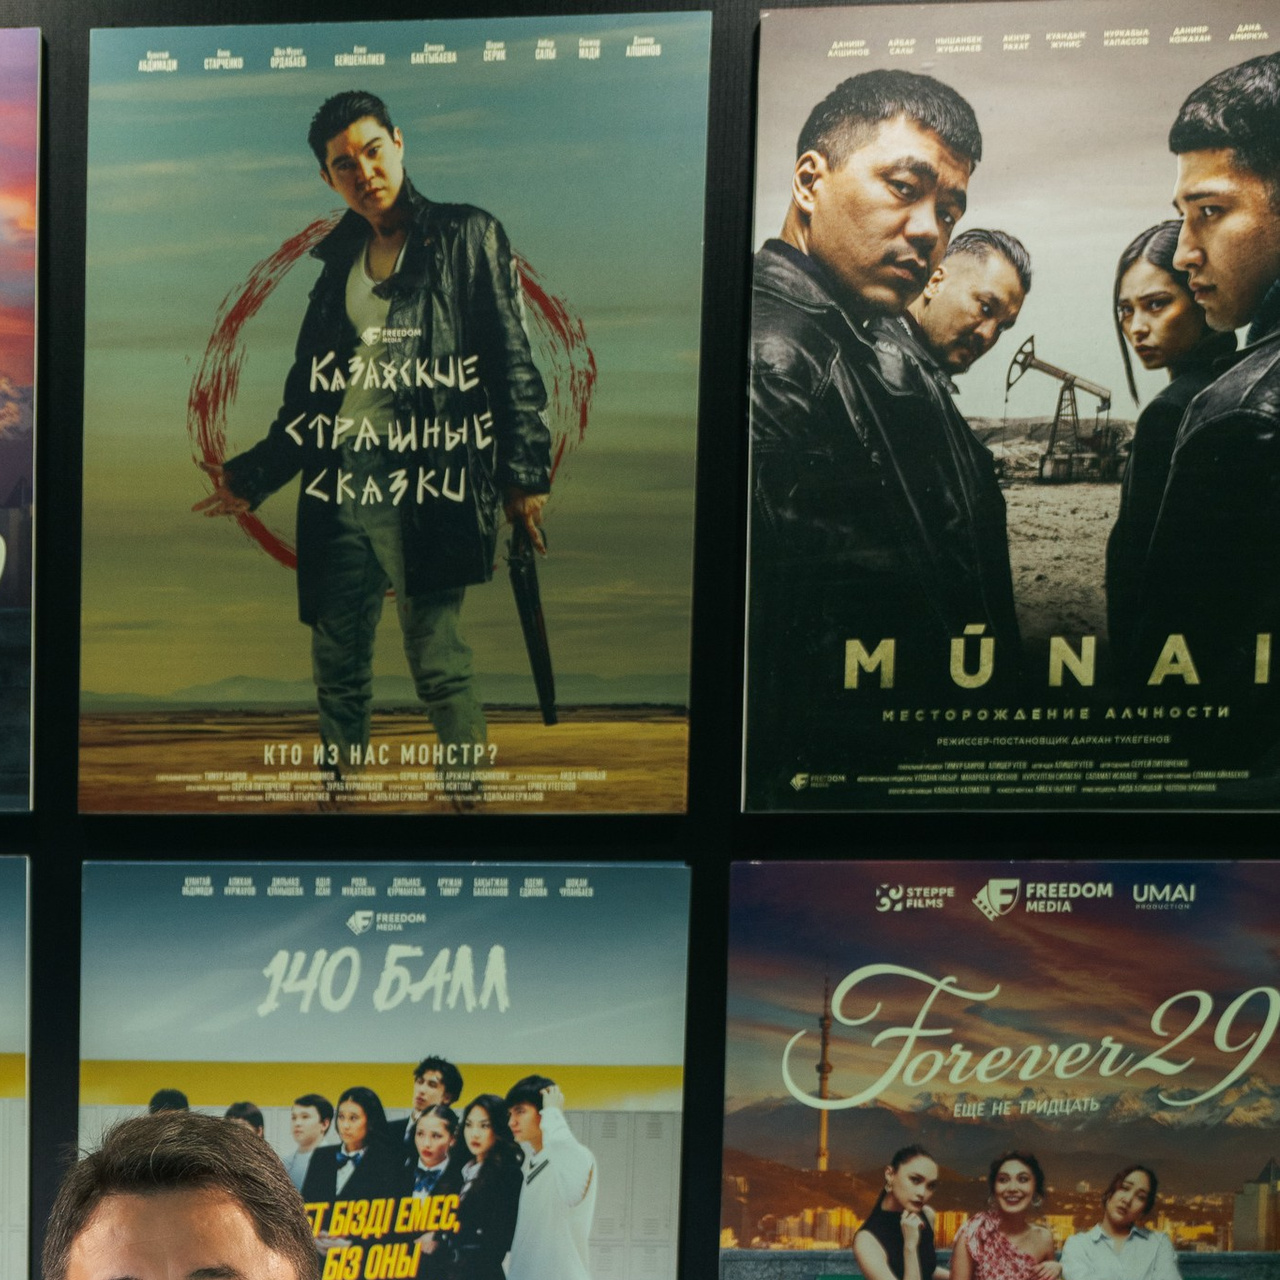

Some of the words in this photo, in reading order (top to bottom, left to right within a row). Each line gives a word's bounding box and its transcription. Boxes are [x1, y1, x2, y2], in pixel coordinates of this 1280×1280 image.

[305, 466, 466, 506] СКАЗКИ
[882, 706, 1090, 722] МЕСТОРОЖДЕНИЕ
[1104, 705, 1230, 720] АЛЧНОСТИ
[264, 744, 302, 766] КТО
[312, 744, 339, 766] ИЗ
[350, 744, 390, 766] НАС
[400, 743, 498, 766] МОНСТР?
[906, 887, 955, 897] STEPPE
[1026, 882, 1113, 899] FREEDOM
[1132, 884, 1196, 902] UMAI
[906, 898, 944, 908] FILMS
[1026, 900, 1071, 912] MEDIA
[376, 912, 426, 924] FREEDOM
[376, 923, 403, 932] MEDIA
[257, 945, 361, 1017] 140
[953, 1101, 985, 1119] ЕЩЕ
[990, 1099, 1012, 1117] НЕ
[1018, 1096, 1100, 1117] ТРИДЦАТЬ
[328, 1198, 395, 1239] БІЗДІ
[394, 1193, 461, 1233] ЕМЕС,
[363, 1241, 422, 1280] ОНЫ
